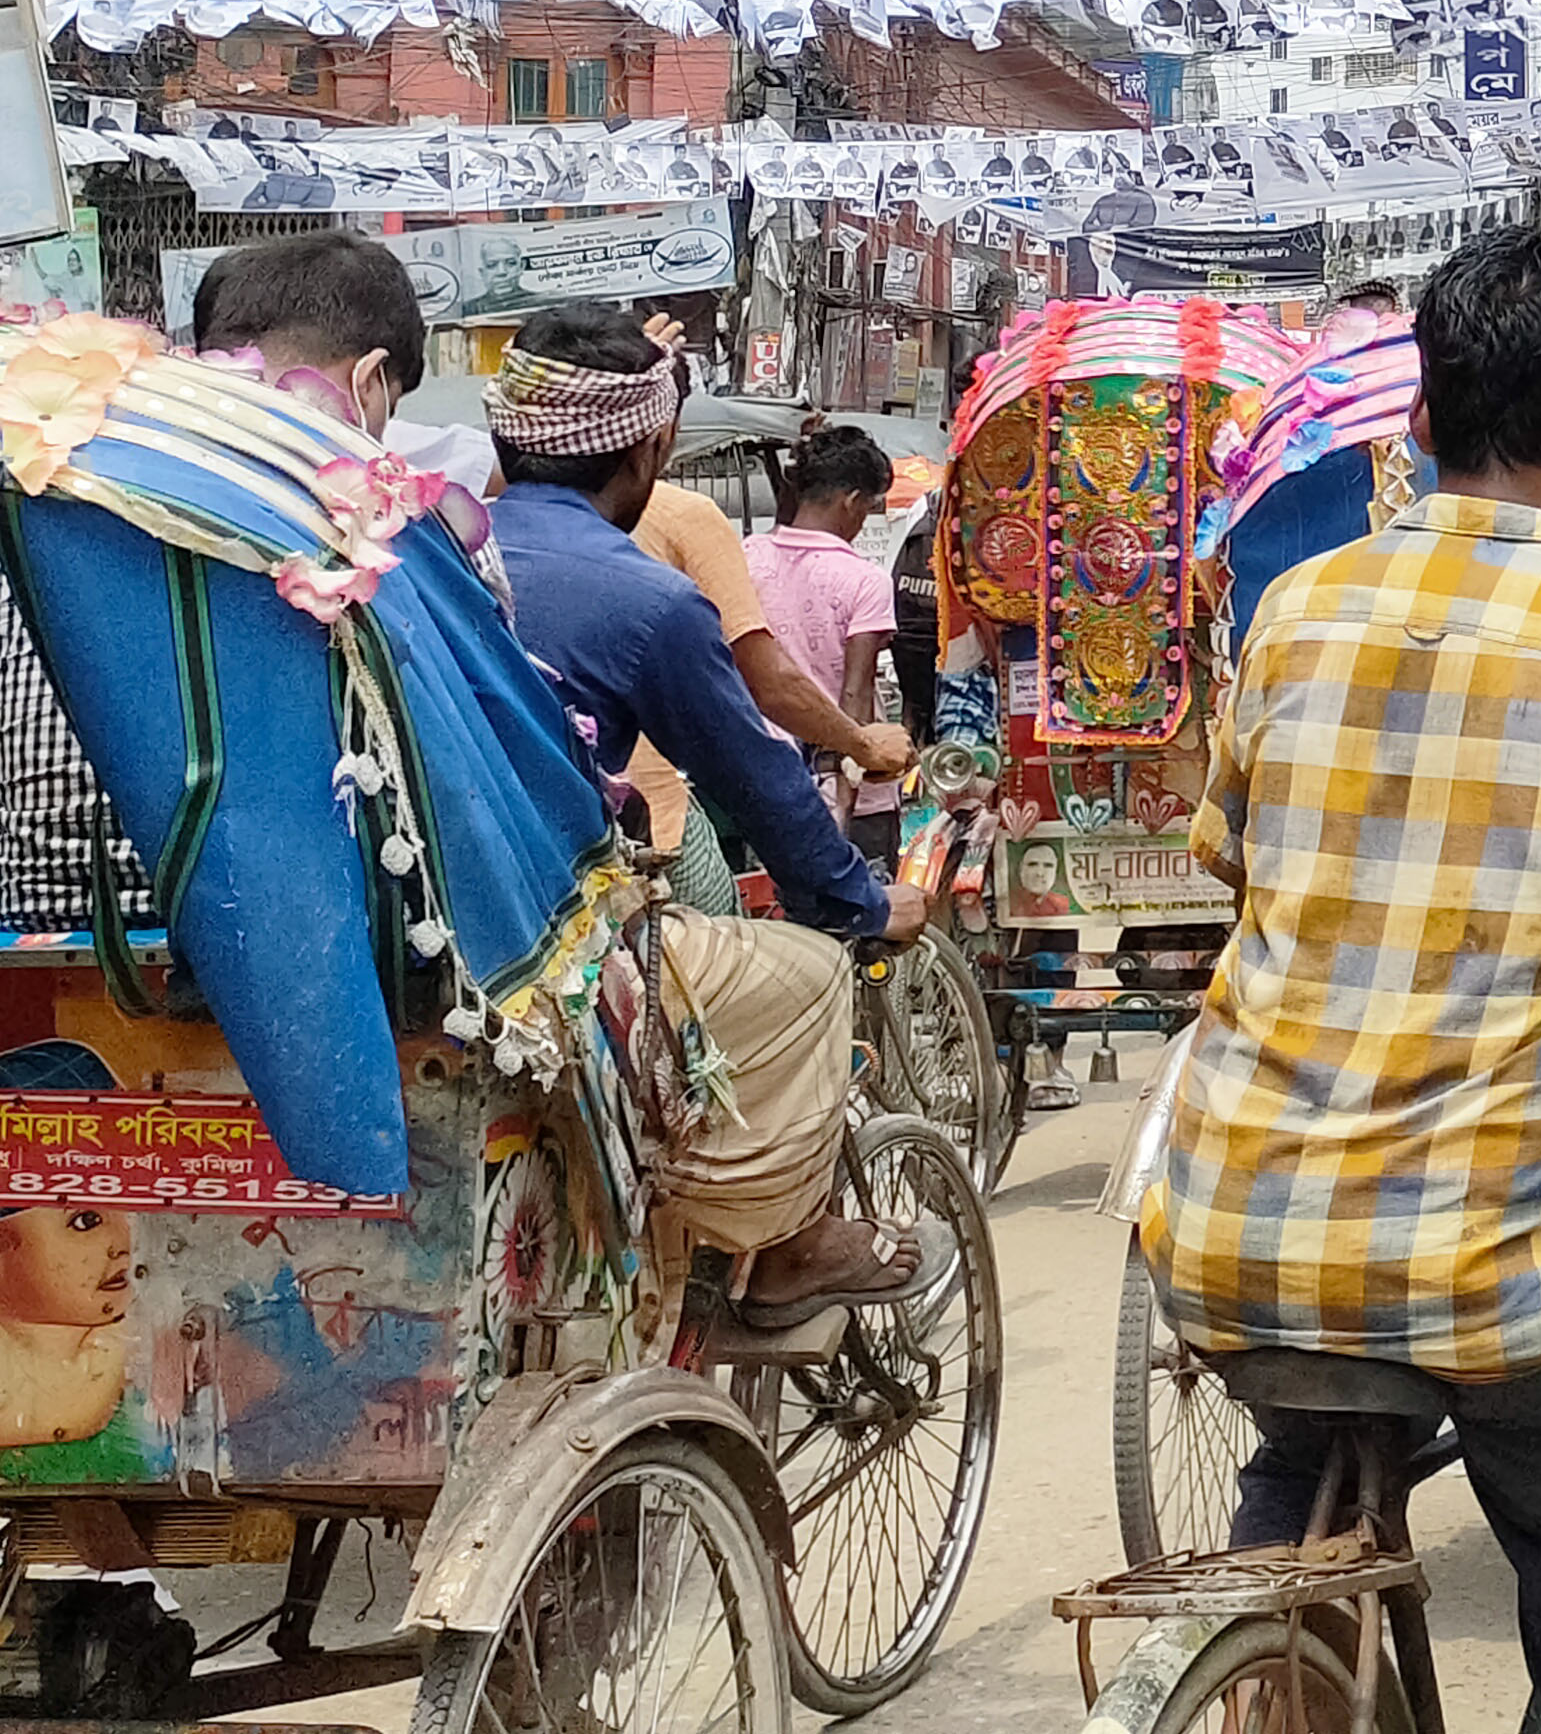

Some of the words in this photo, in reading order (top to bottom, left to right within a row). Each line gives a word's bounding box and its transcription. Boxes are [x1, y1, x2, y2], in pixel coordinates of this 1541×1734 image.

[899, 575, 938, 596] PUM
[1069, 848, 1192, 881] মা-বাবার
[0, 1104, 103, 1148] মিল্লাহ
[45, 1151, 111, 1170] দক্ষিণ
[180, 1153, 254, 1177] কুমিল্লা
[9, 1171, 388, 1202] 828-55153
